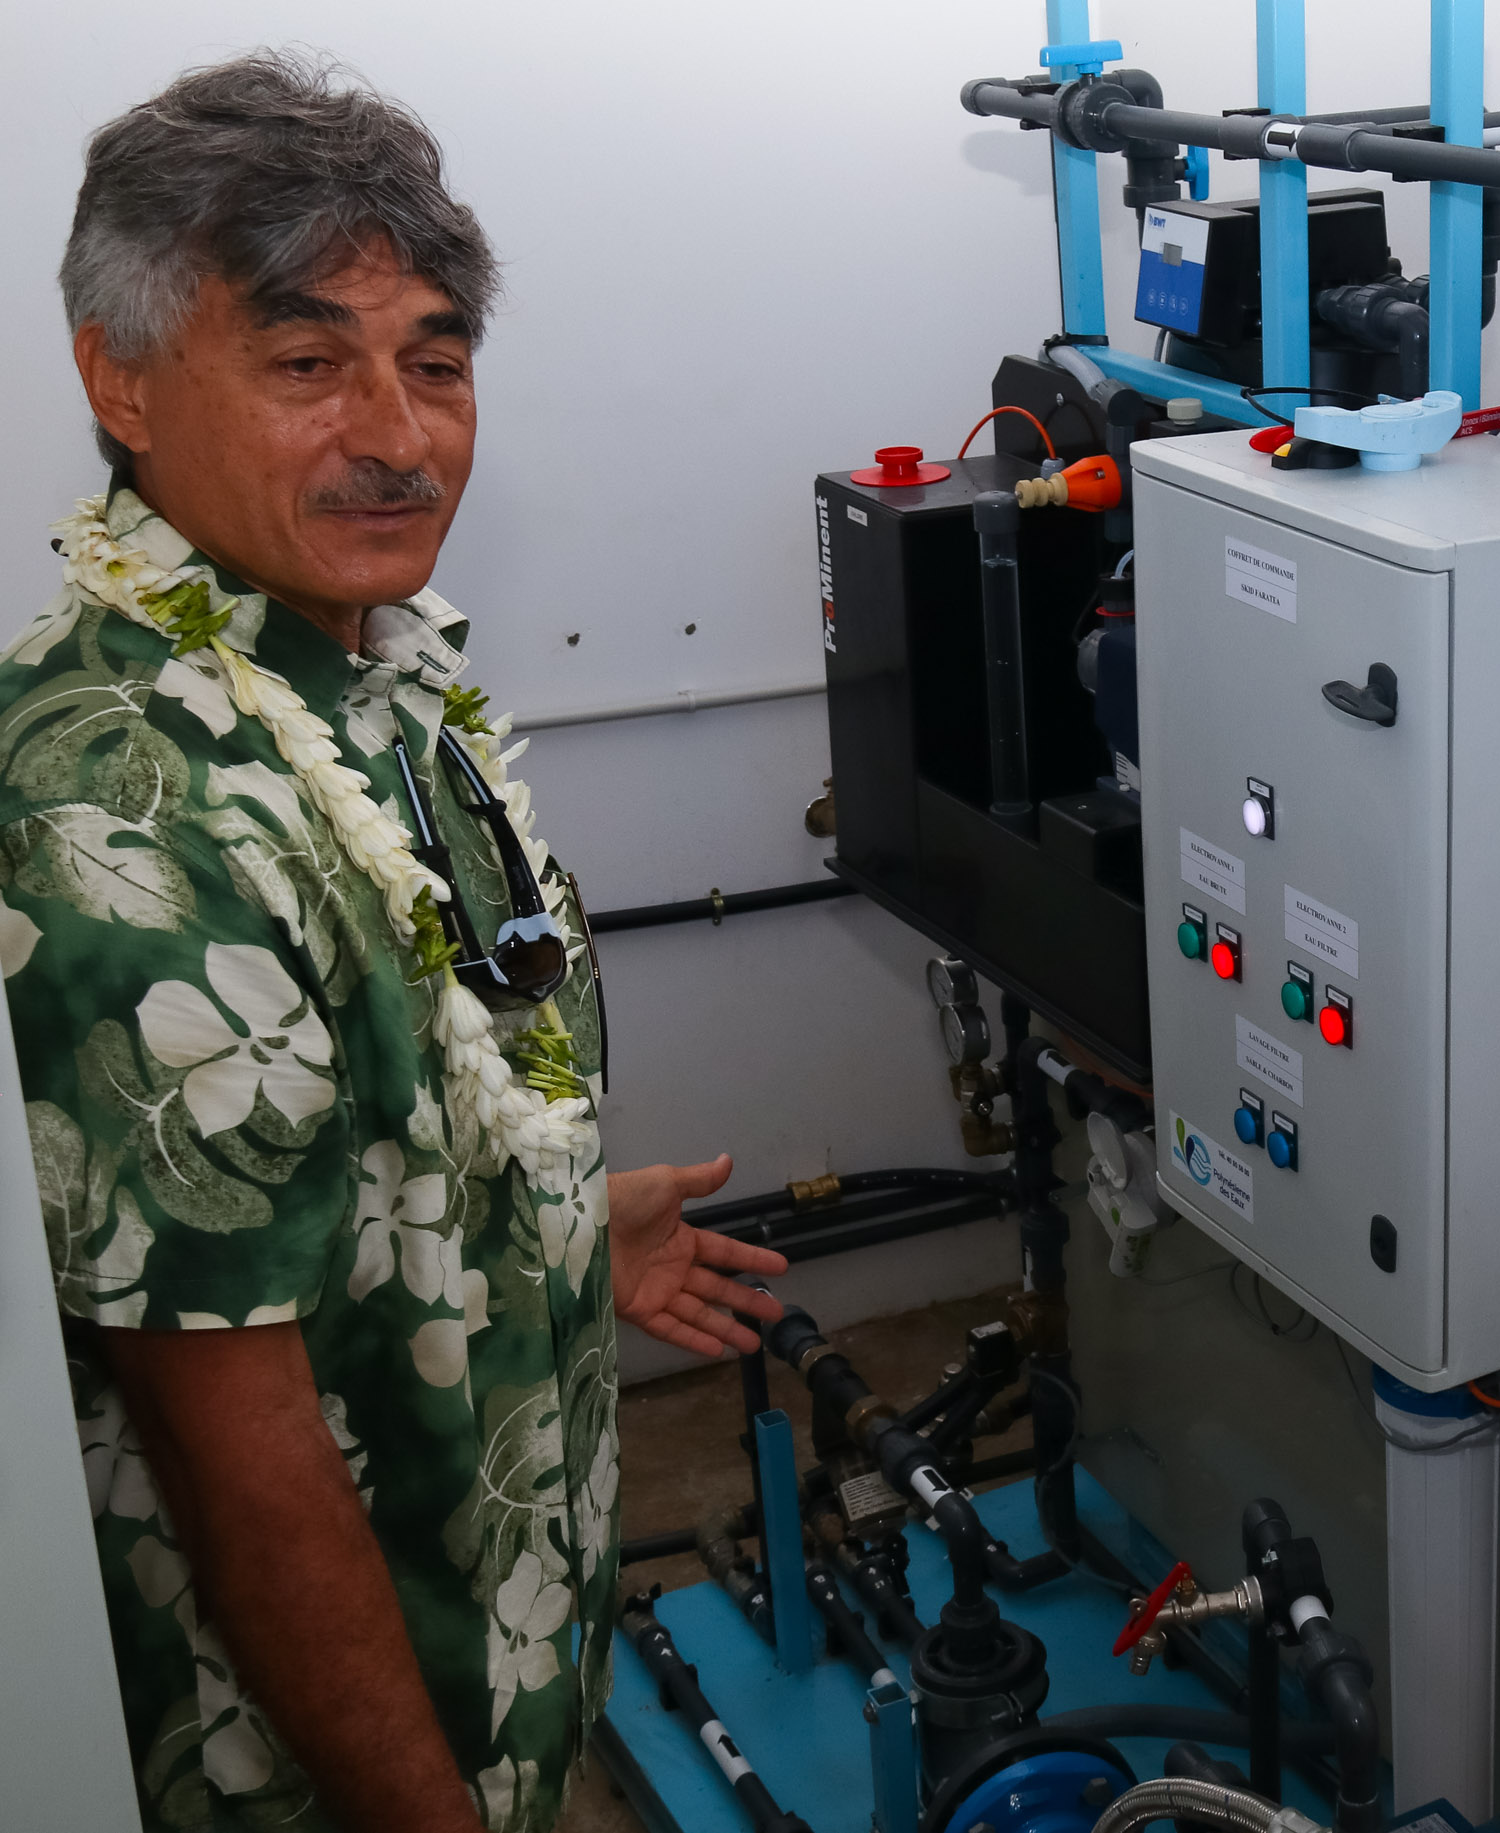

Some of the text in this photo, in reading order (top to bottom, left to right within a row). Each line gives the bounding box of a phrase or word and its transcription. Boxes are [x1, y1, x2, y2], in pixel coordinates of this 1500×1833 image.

[1154, 217, 1166, 228] BWT
[1461, 427, 1473, 436] ACS
[816, 495, 837, 653] ProMinent
[1227, 548, 1295, 581] COFFRET DE COMMANDE
[1241, 583, 1255, 595] SKID
[1190, 842, 1231, 871] ELECTROVANNE
[1199, 874, 1227, 895] EAU BRUTE
[1296, 901, 1347, 934] ELECTROVANNE 2
[1304, 933, 1338, 958] EAU FILTRE
[1249, 1031, 1289, 1063] LAVAGE FILTRE
[1245, 1055, 1294, 1091] SABLE & CHARBON
[1213, 1168, 1251, 1202] Polynésienne
[1219, 1186, 1245, 1210] des Eaux
